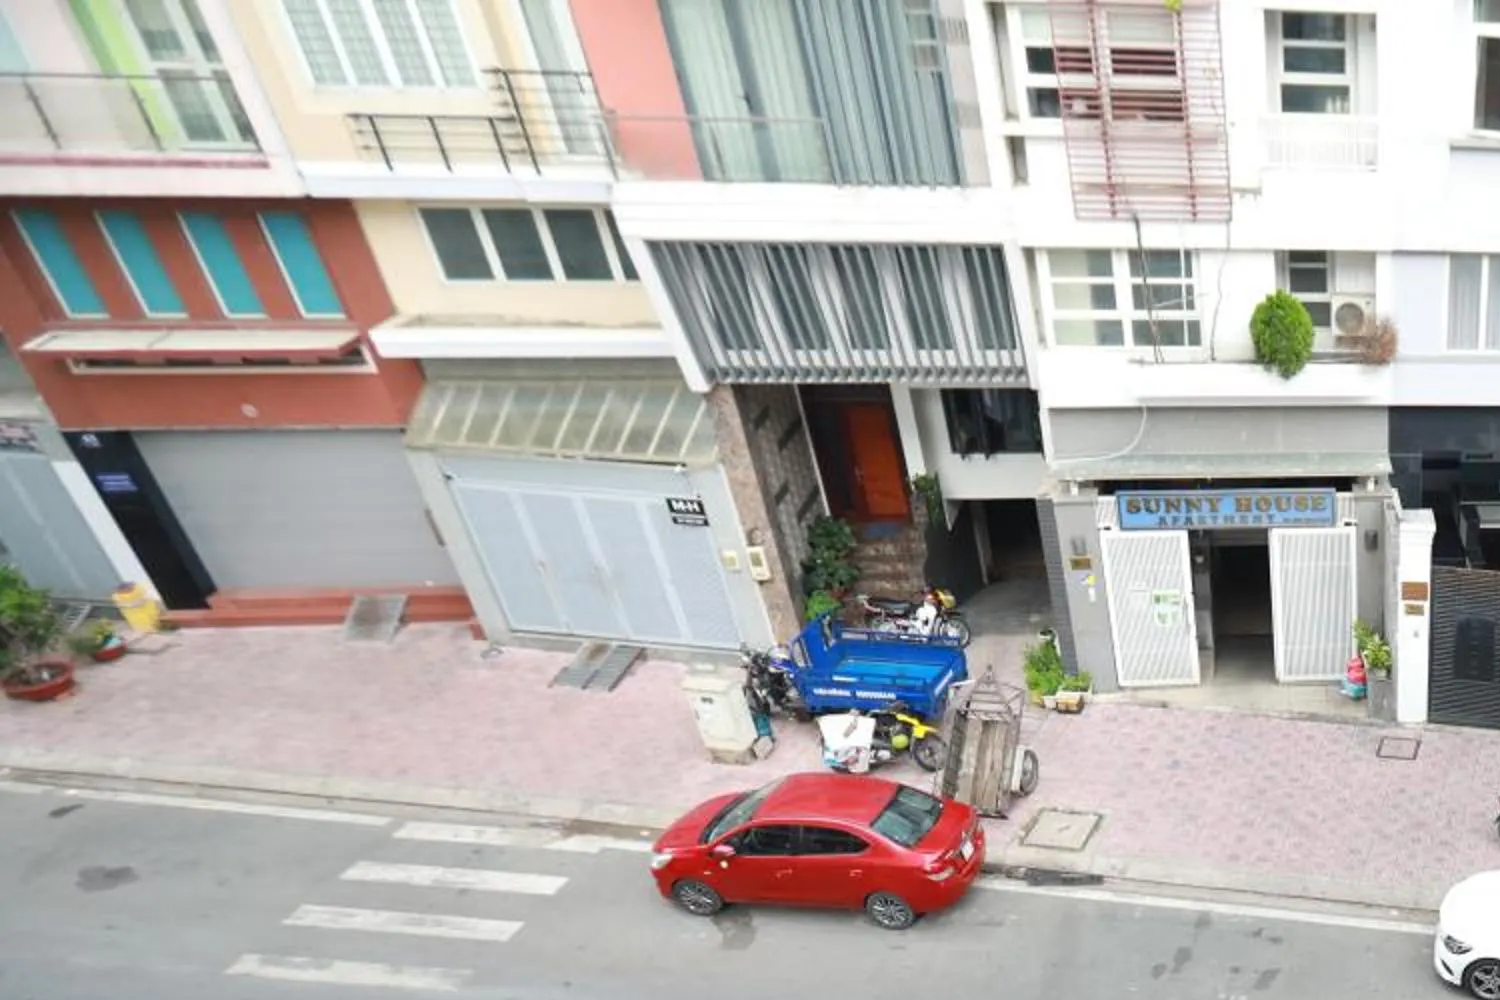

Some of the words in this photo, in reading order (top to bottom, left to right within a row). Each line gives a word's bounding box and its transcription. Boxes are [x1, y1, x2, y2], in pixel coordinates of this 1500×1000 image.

[1125, 496, 1223, 514] SUNNY
[1235, 495, 1327, 513] HOUSE
[1158, 514, 1276, 527] APARTMENT
